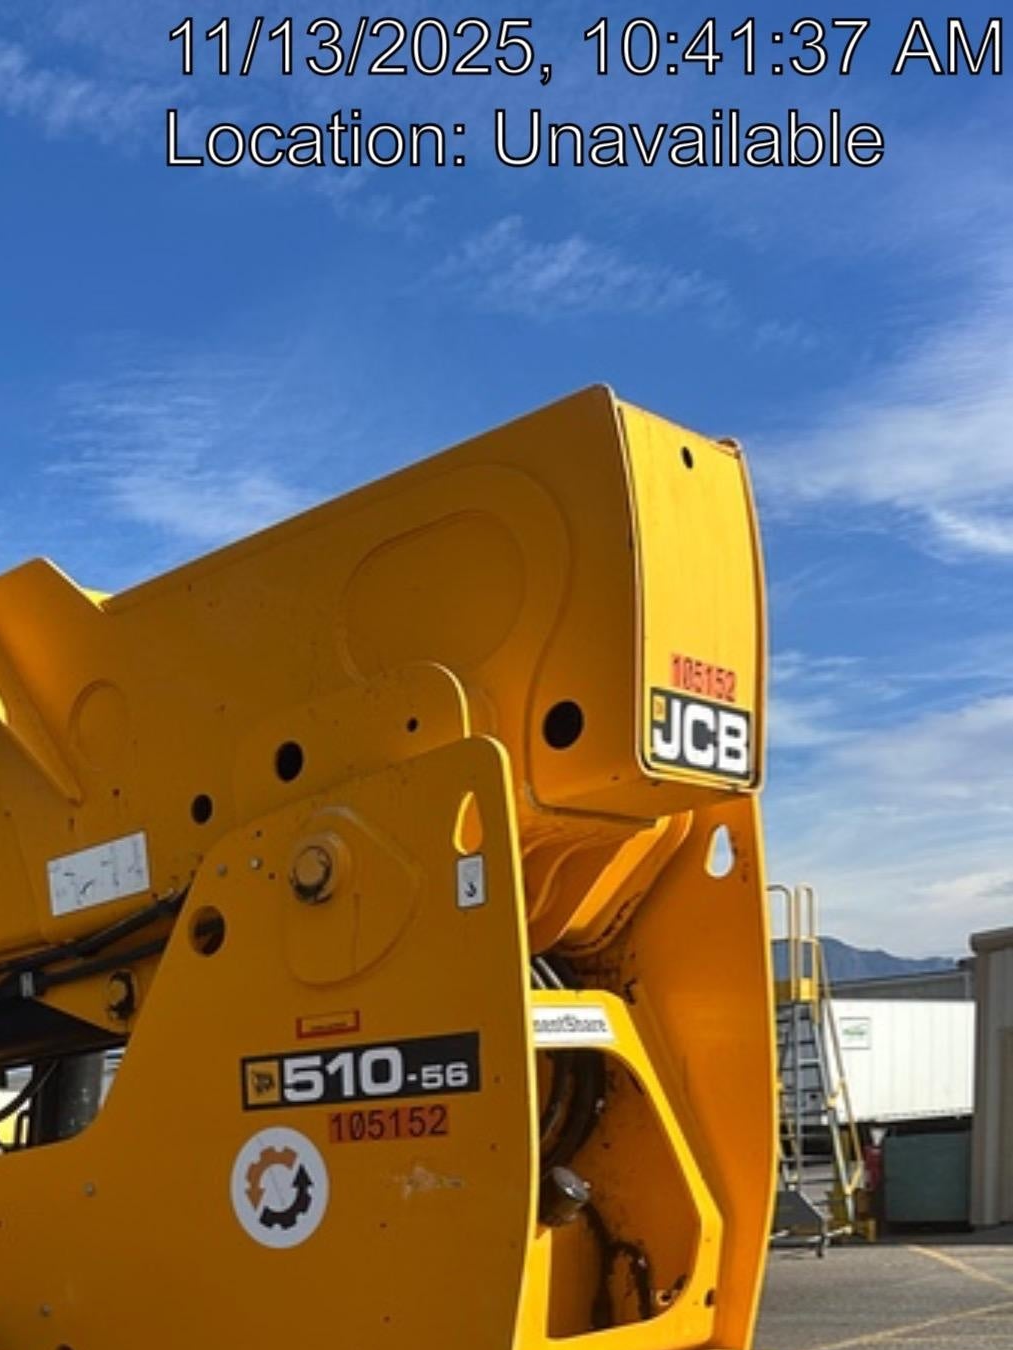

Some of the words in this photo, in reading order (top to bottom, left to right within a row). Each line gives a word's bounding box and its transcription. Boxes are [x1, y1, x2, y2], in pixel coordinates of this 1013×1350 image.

[673, 654, 735, 702] 105152
[652, 699, 747, 773] JCB
[283, 1045, 469, 1103] 510-56
[331, 1105, 448, 1142] 105152
